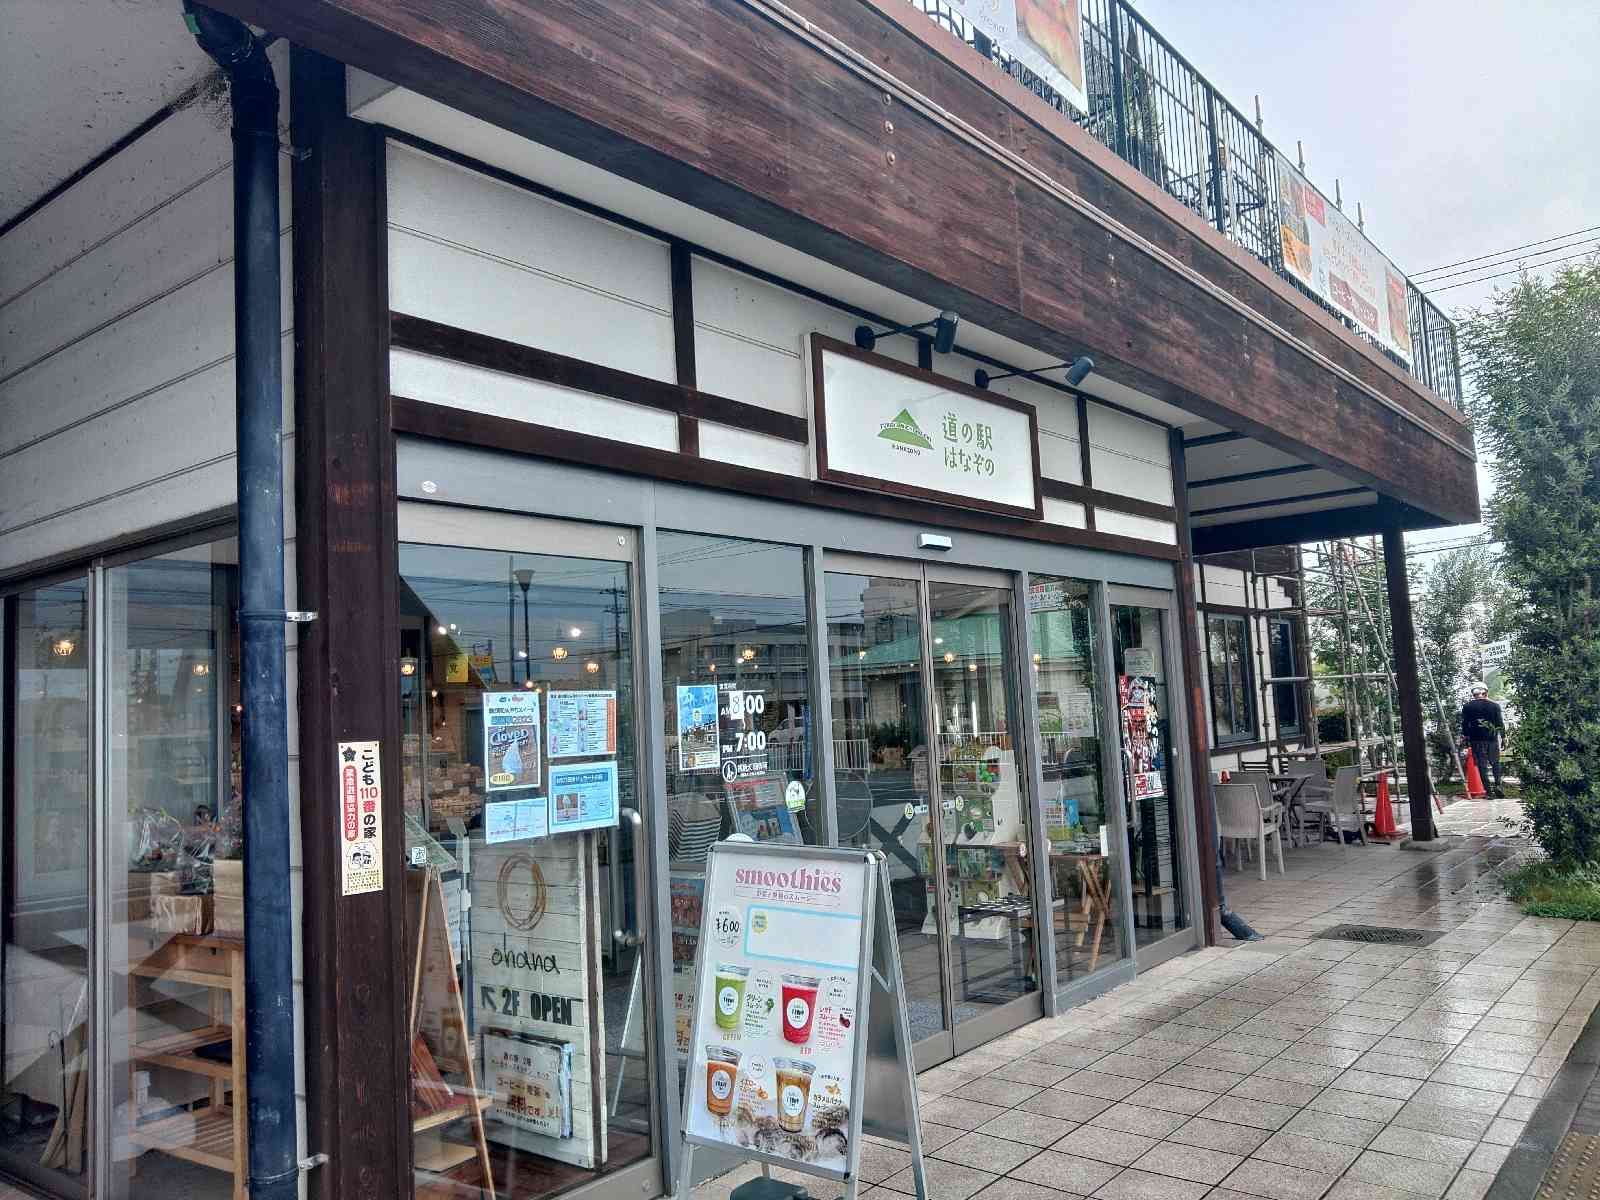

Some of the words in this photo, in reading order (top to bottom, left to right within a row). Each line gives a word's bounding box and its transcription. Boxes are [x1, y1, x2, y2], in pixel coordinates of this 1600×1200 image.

[942, 410, 993, 452] 道の駅
[943, 447, 995, 477] はなぞの
[735, 731, 766, 753] 7:00
[359, 749, 379, 840] こども110番の家
[735, 866, 841, 894] smoothies
[490, 932, 561, 975] ohana
[501, 988, 520, 1018] 2F
[530, 993, 572, 1026] OPEN
